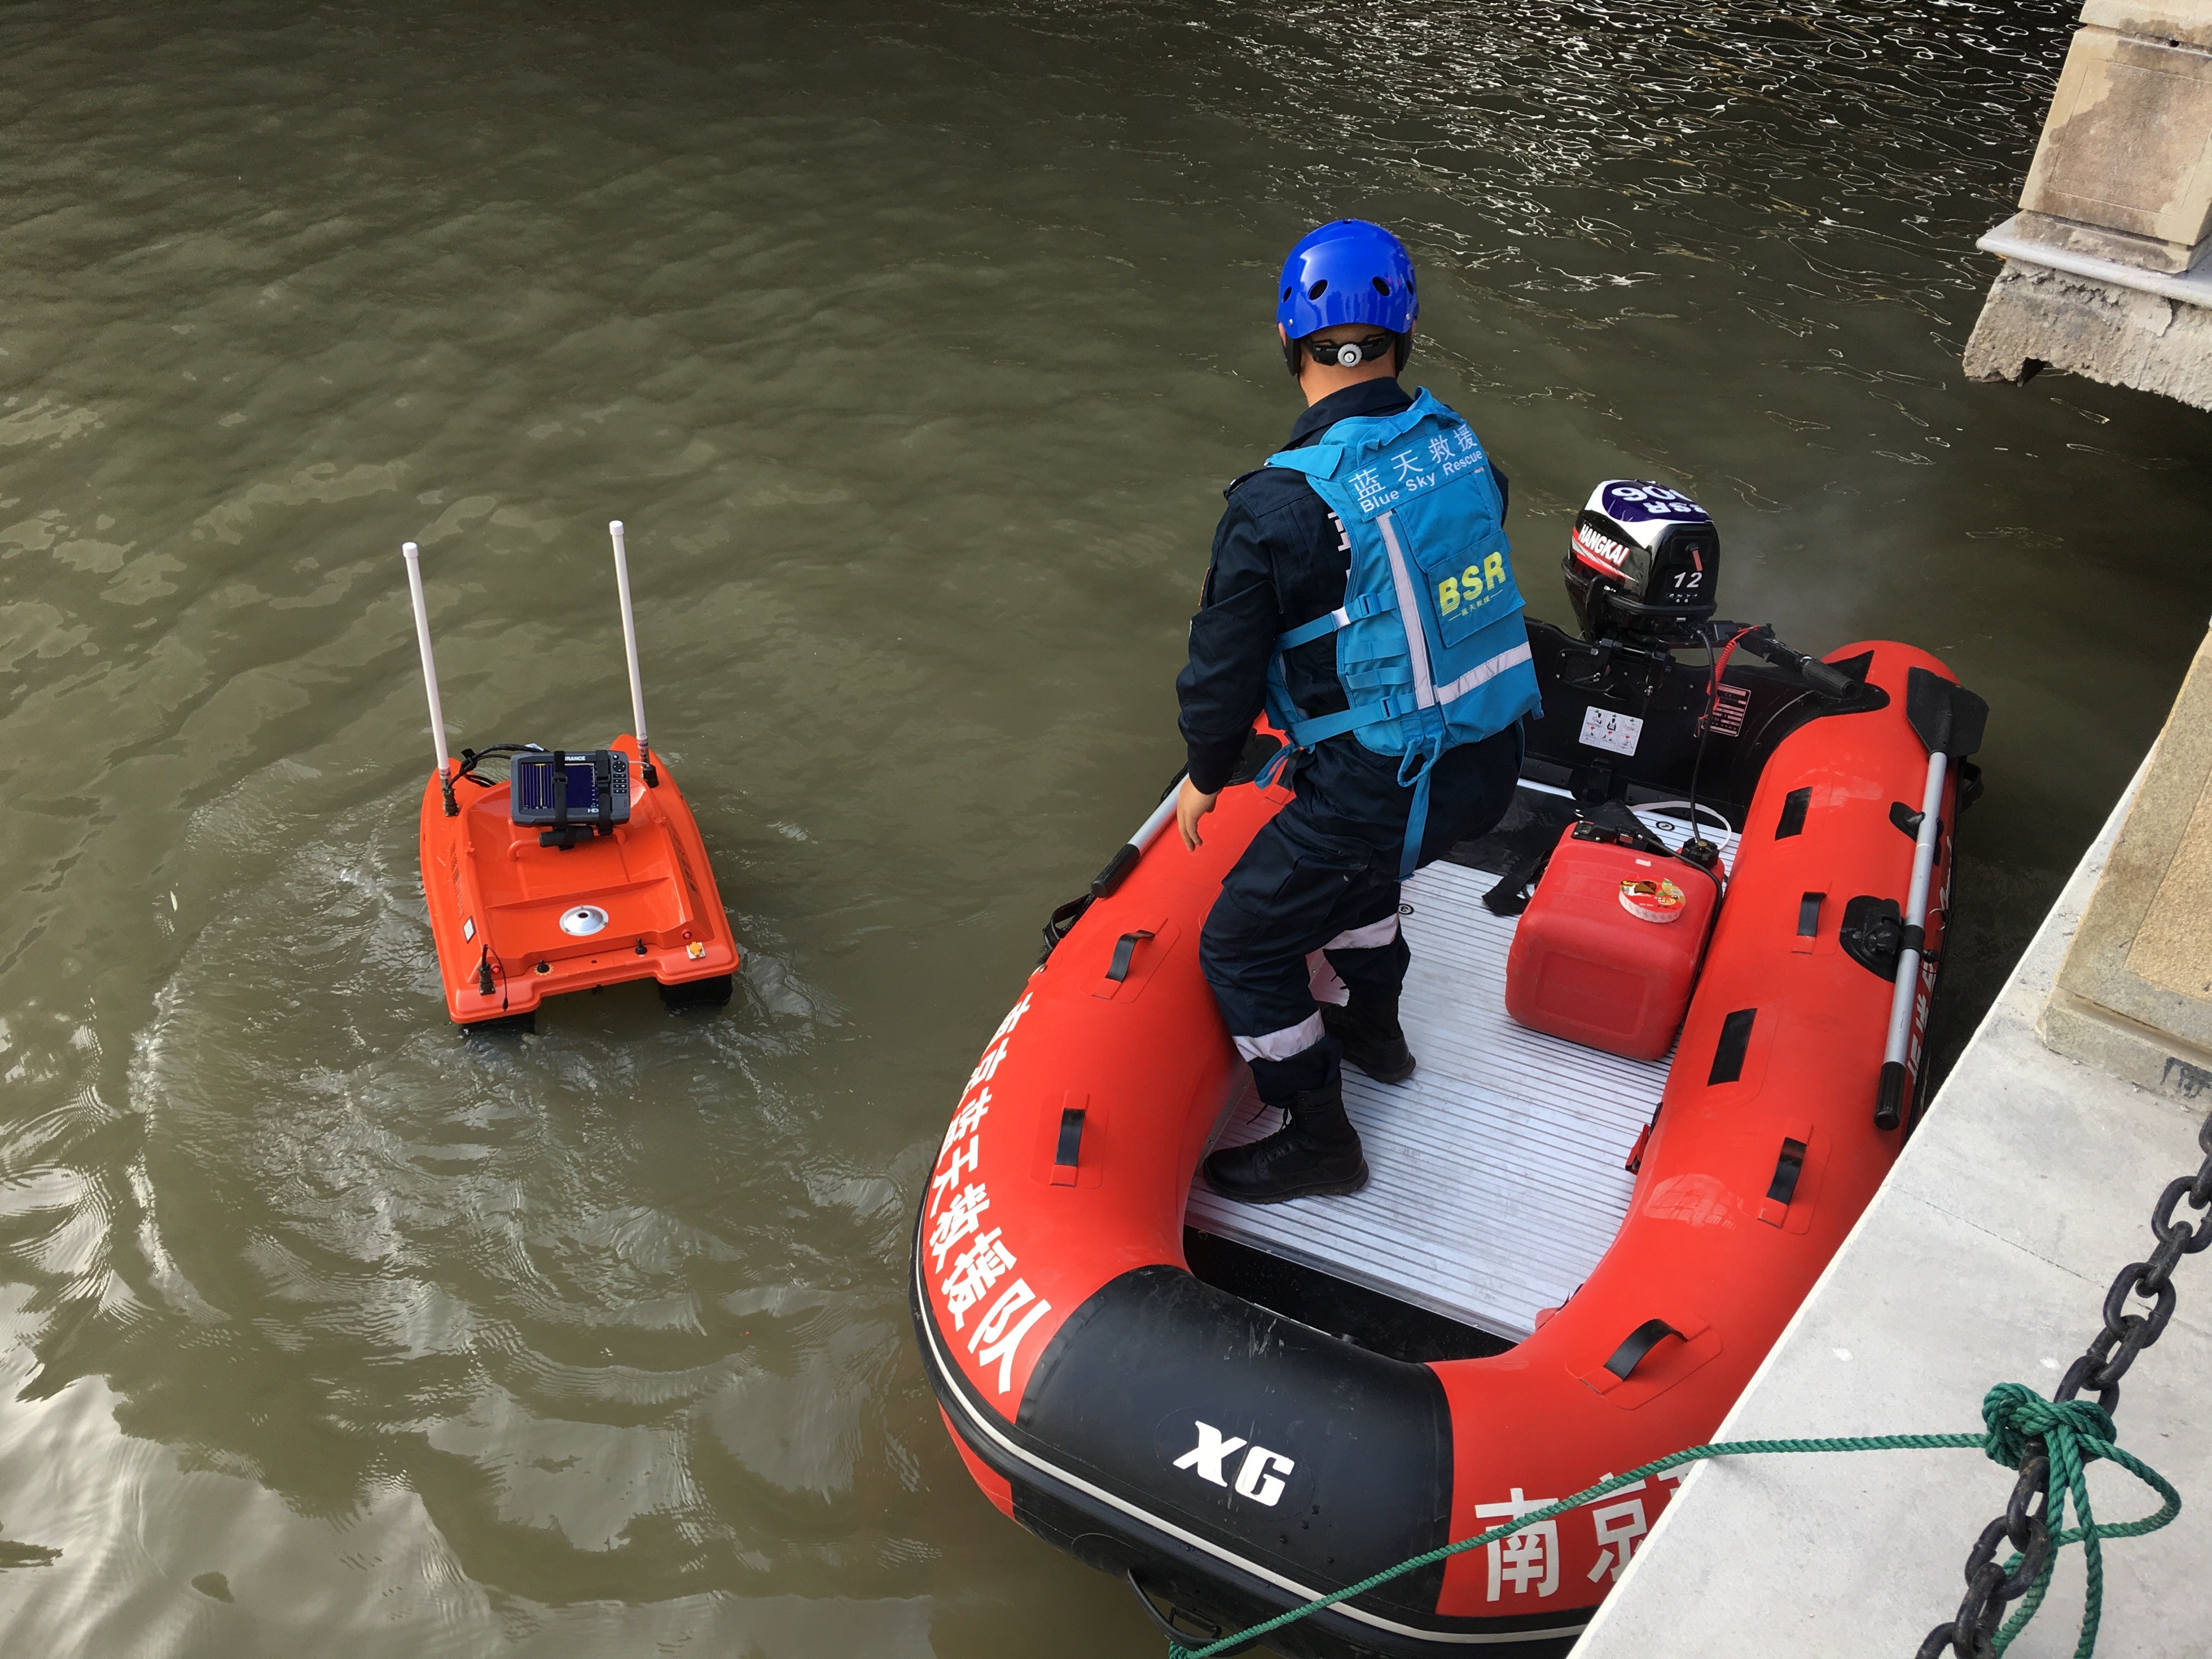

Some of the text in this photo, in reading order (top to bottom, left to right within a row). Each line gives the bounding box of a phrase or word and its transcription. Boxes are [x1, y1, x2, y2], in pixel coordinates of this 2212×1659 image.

[1348, 424, 1477, 501] 蓝天救援
[1359, 450, 1483, 514] Blue Sky Rescue
[1578, 523, 1630, 565] HANGKAI
[1438, 551, 1506, 617] BSR
[1674, 572, 1702, 588] 12
[1172, 1420, 1295, 1508] XG
[1475, 1459, 1697, 1603] 南京
